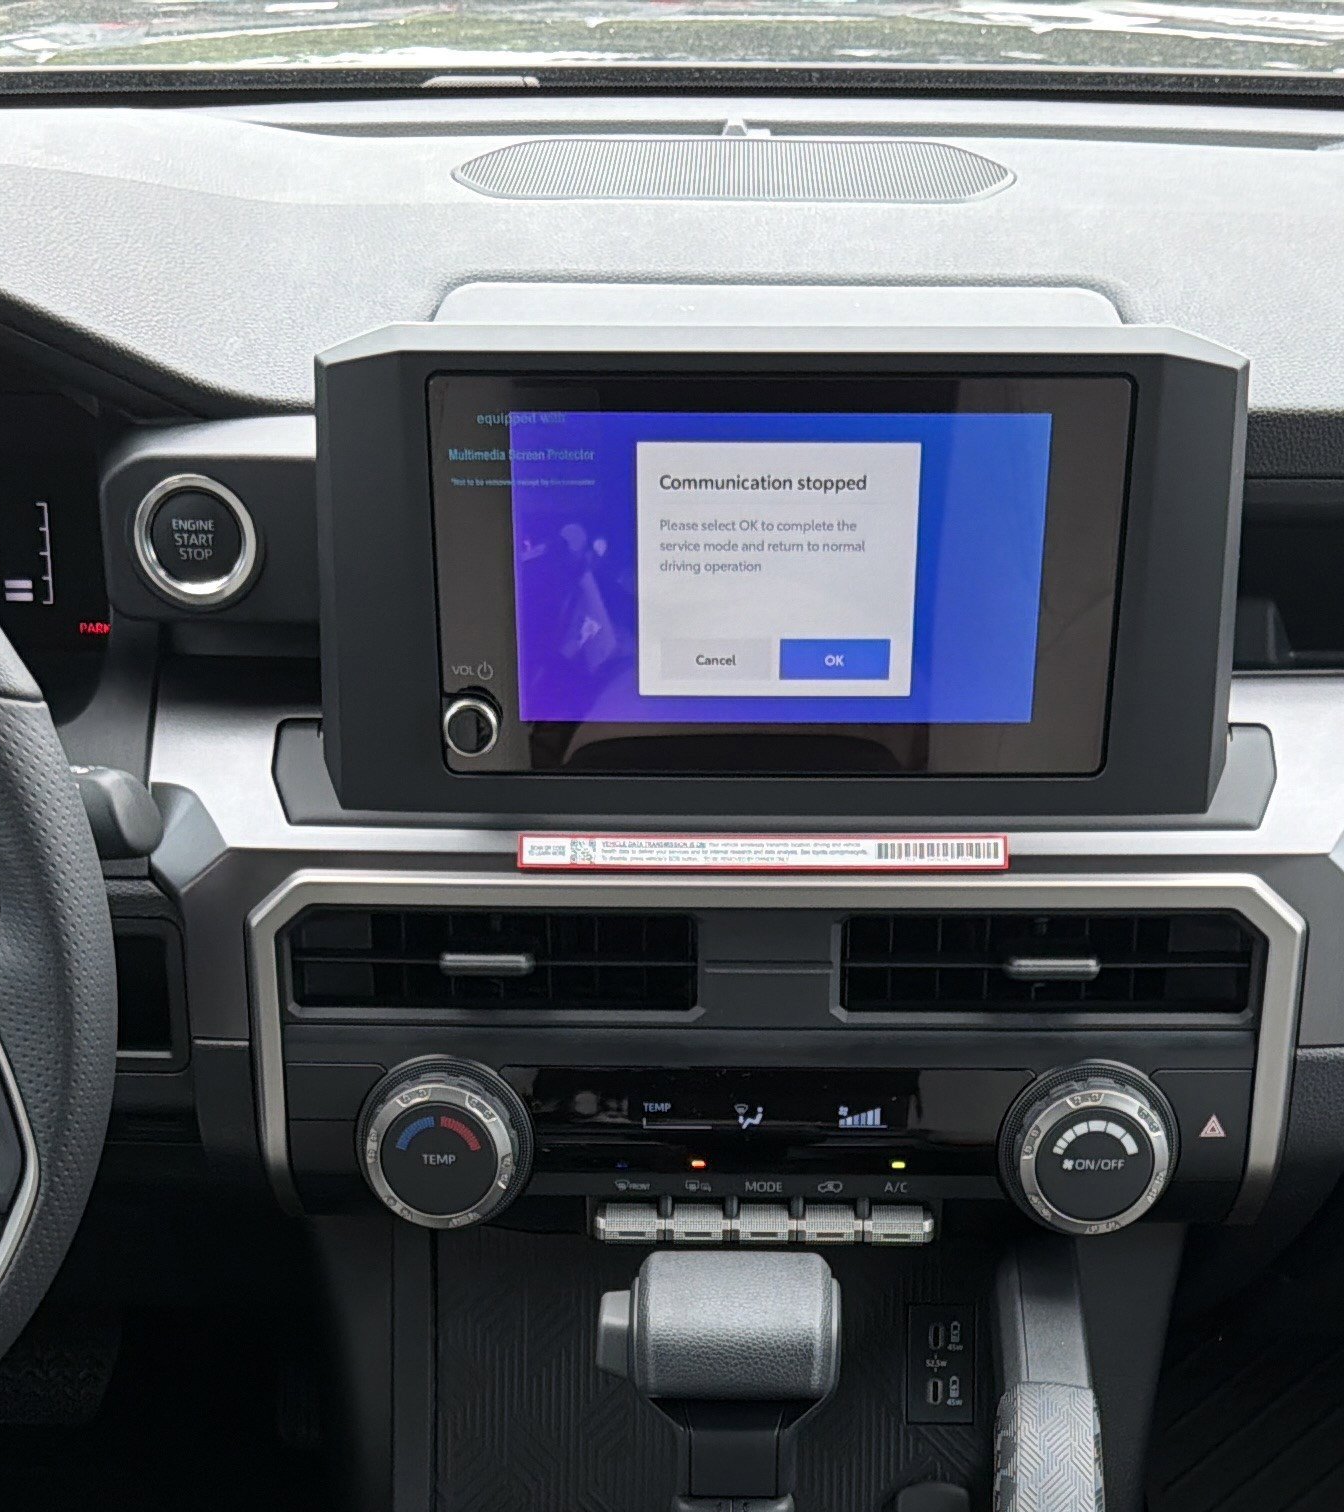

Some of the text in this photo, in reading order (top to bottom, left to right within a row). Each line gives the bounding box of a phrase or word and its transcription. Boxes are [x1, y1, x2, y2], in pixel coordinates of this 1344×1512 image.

[476, 412, 536, 426] equipped
[448, 448, 505, 461] Multimedia
[508, 448, 545, 461] Screen
[659, 474, 868, 494] Communication stopped
[171, 518, 215, 531] ENGINE
[659, 519, 857, 535] Please select OK to complete the
[174, 532, 214, 546] START
[178, 547, 213, 560] STOP
[659, 541, 866, 553] service mode and return to normal
[659, 560, 762, 575] driving operation
[695, 654, 737, 666] Cancel
[824, 655, 845, 667] OK
[451, 665, 475, 676] VOL
[642, 1101, 672, 1113] TEMP
[422, 1153, 456, 1166] TEMP
[1074, 1158, 1125, 1171] ON/OFF
[744, 1180, 784, 1193] MODE
[884, 1180, 908, 1193] A/C
